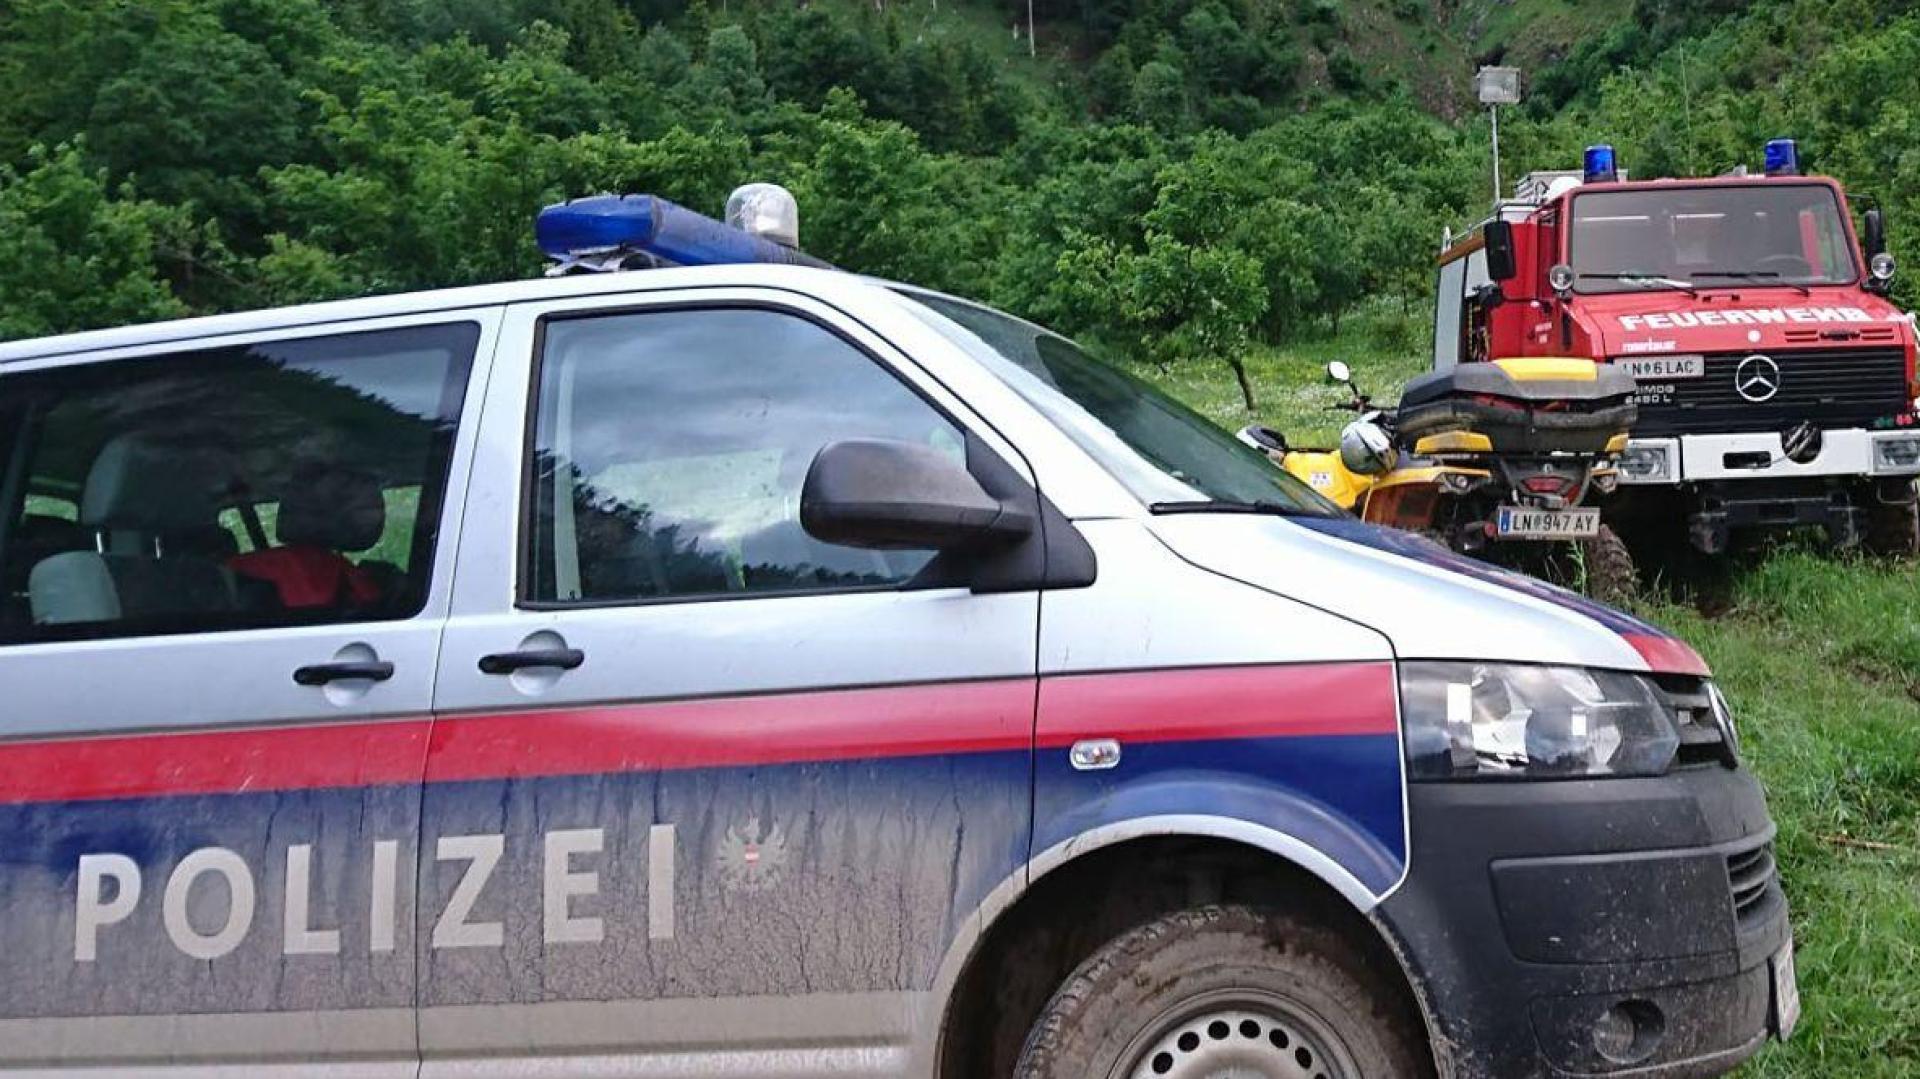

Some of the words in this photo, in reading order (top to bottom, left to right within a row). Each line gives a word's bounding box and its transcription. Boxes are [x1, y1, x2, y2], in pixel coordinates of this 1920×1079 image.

[1618, 308, 1873, 331] FEUERWEHR
[1513, 514, 1531, 531] LN
[1575, 514, 1595, 531] AY
[74, 823, 676, 962] POLIZEI
